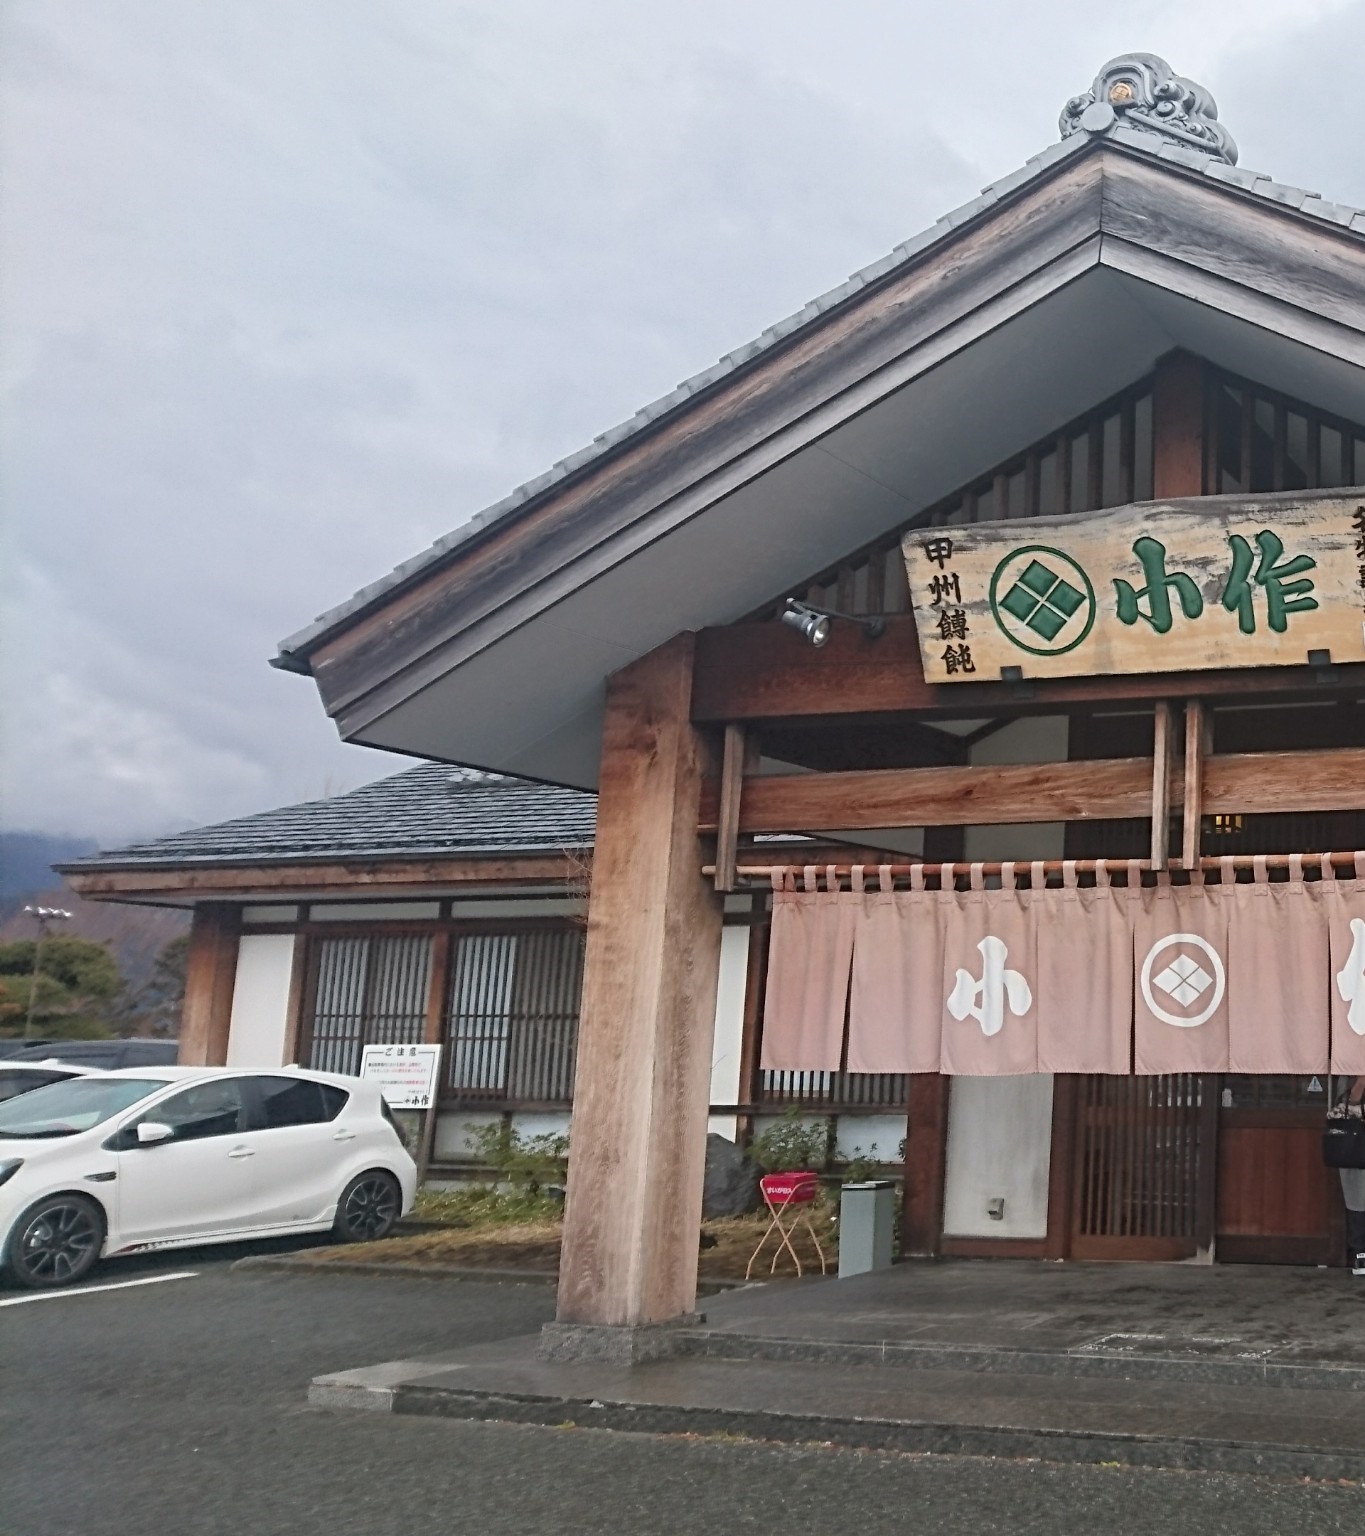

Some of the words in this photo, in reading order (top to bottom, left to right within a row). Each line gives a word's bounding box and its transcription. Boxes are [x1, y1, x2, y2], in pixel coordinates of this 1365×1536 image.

[1112, 530, 1318, 635] 小作
[385, 1047, 417, 1056] ご注意
[411, 1094, 429, 1105] 小作
